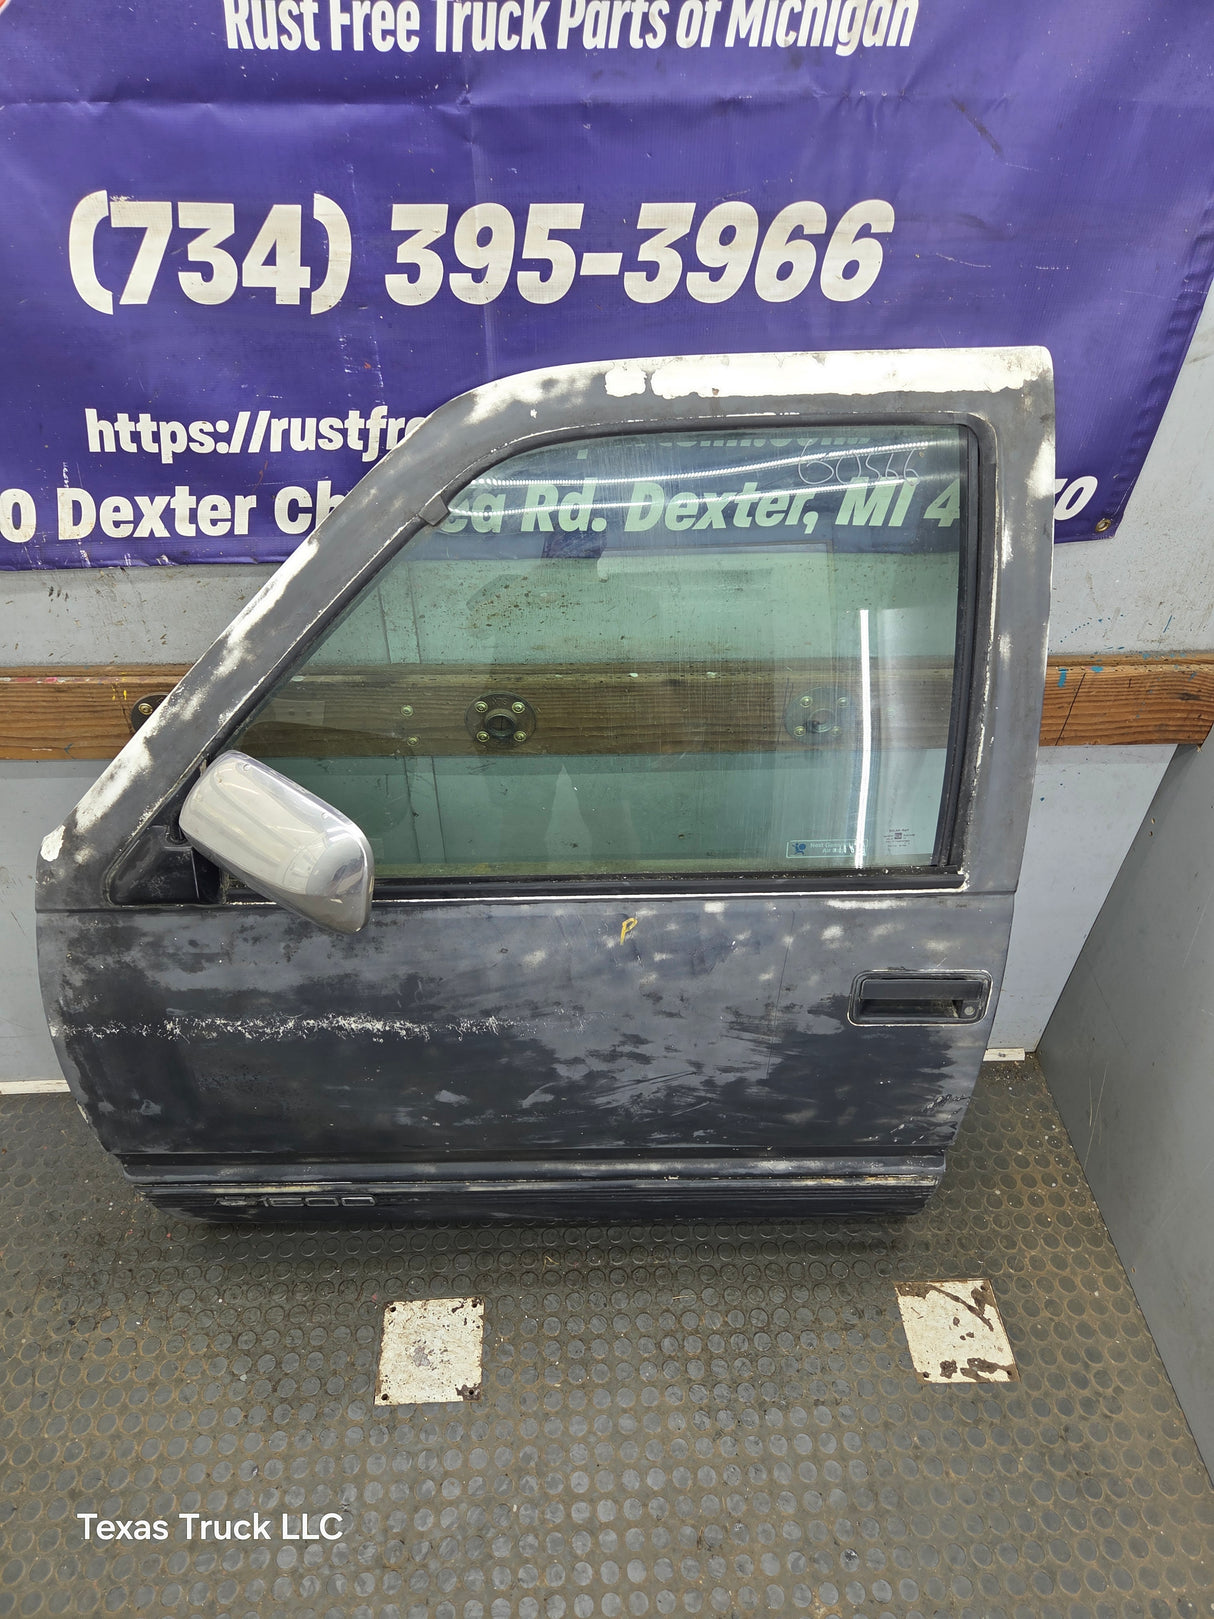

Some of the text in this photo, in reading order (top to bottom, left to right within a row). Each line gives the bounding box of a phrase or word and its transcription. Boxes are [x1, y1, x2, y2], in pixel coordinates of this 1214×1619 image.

[223, 0, 920, 56] Rust Free Truck Parts of Michigan
[68, 190, 895, 315] (734) 395-3966
[57, 485, 256, 541] Dexter
[520, 477, 607, 532] Rd.
[624, 481, 818, 534] Dexter,
[835, 476, 917, 527] MI
[620, 917, 638, 945] P
